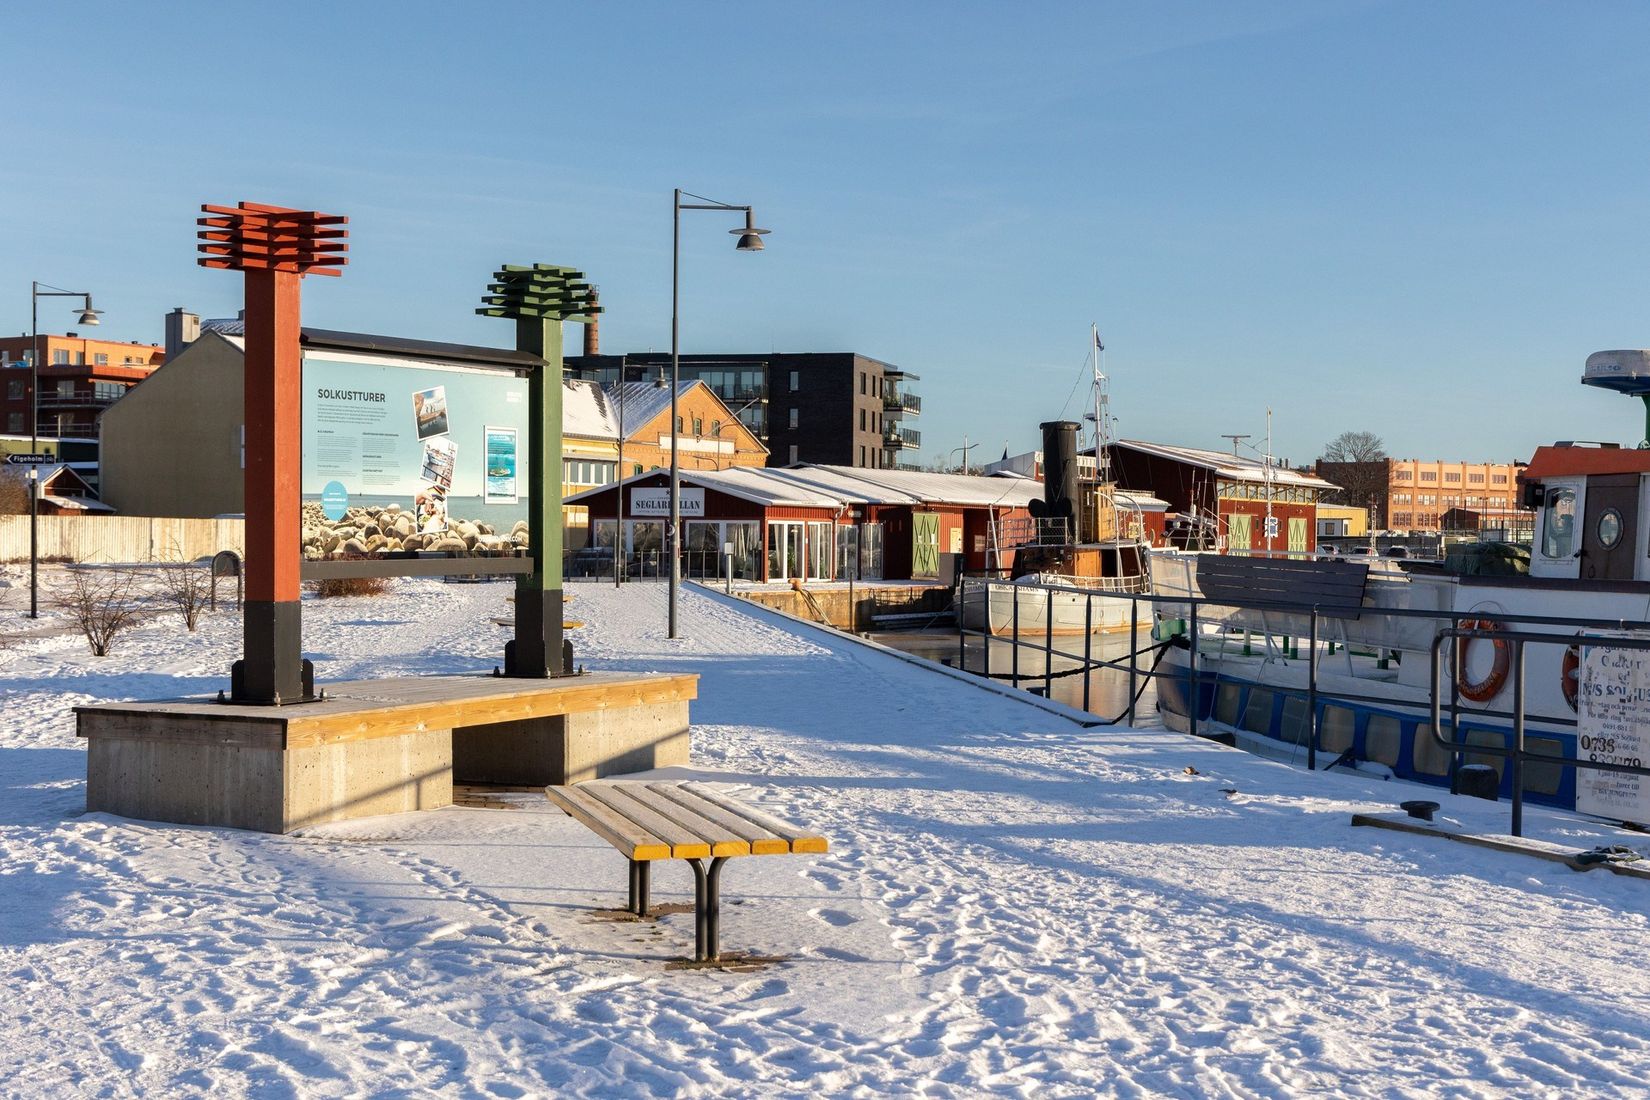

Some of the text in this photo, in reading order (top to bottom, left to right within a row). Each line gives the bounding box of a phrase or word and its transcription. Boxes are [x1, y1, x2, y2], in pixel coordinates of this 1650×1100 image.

[318, 388, 385, 402] SOLKUSTTURER
[635, 500, 700, 510] SEGLARLLAN
[995, 584, 1038, 592] OSKASHAMN
